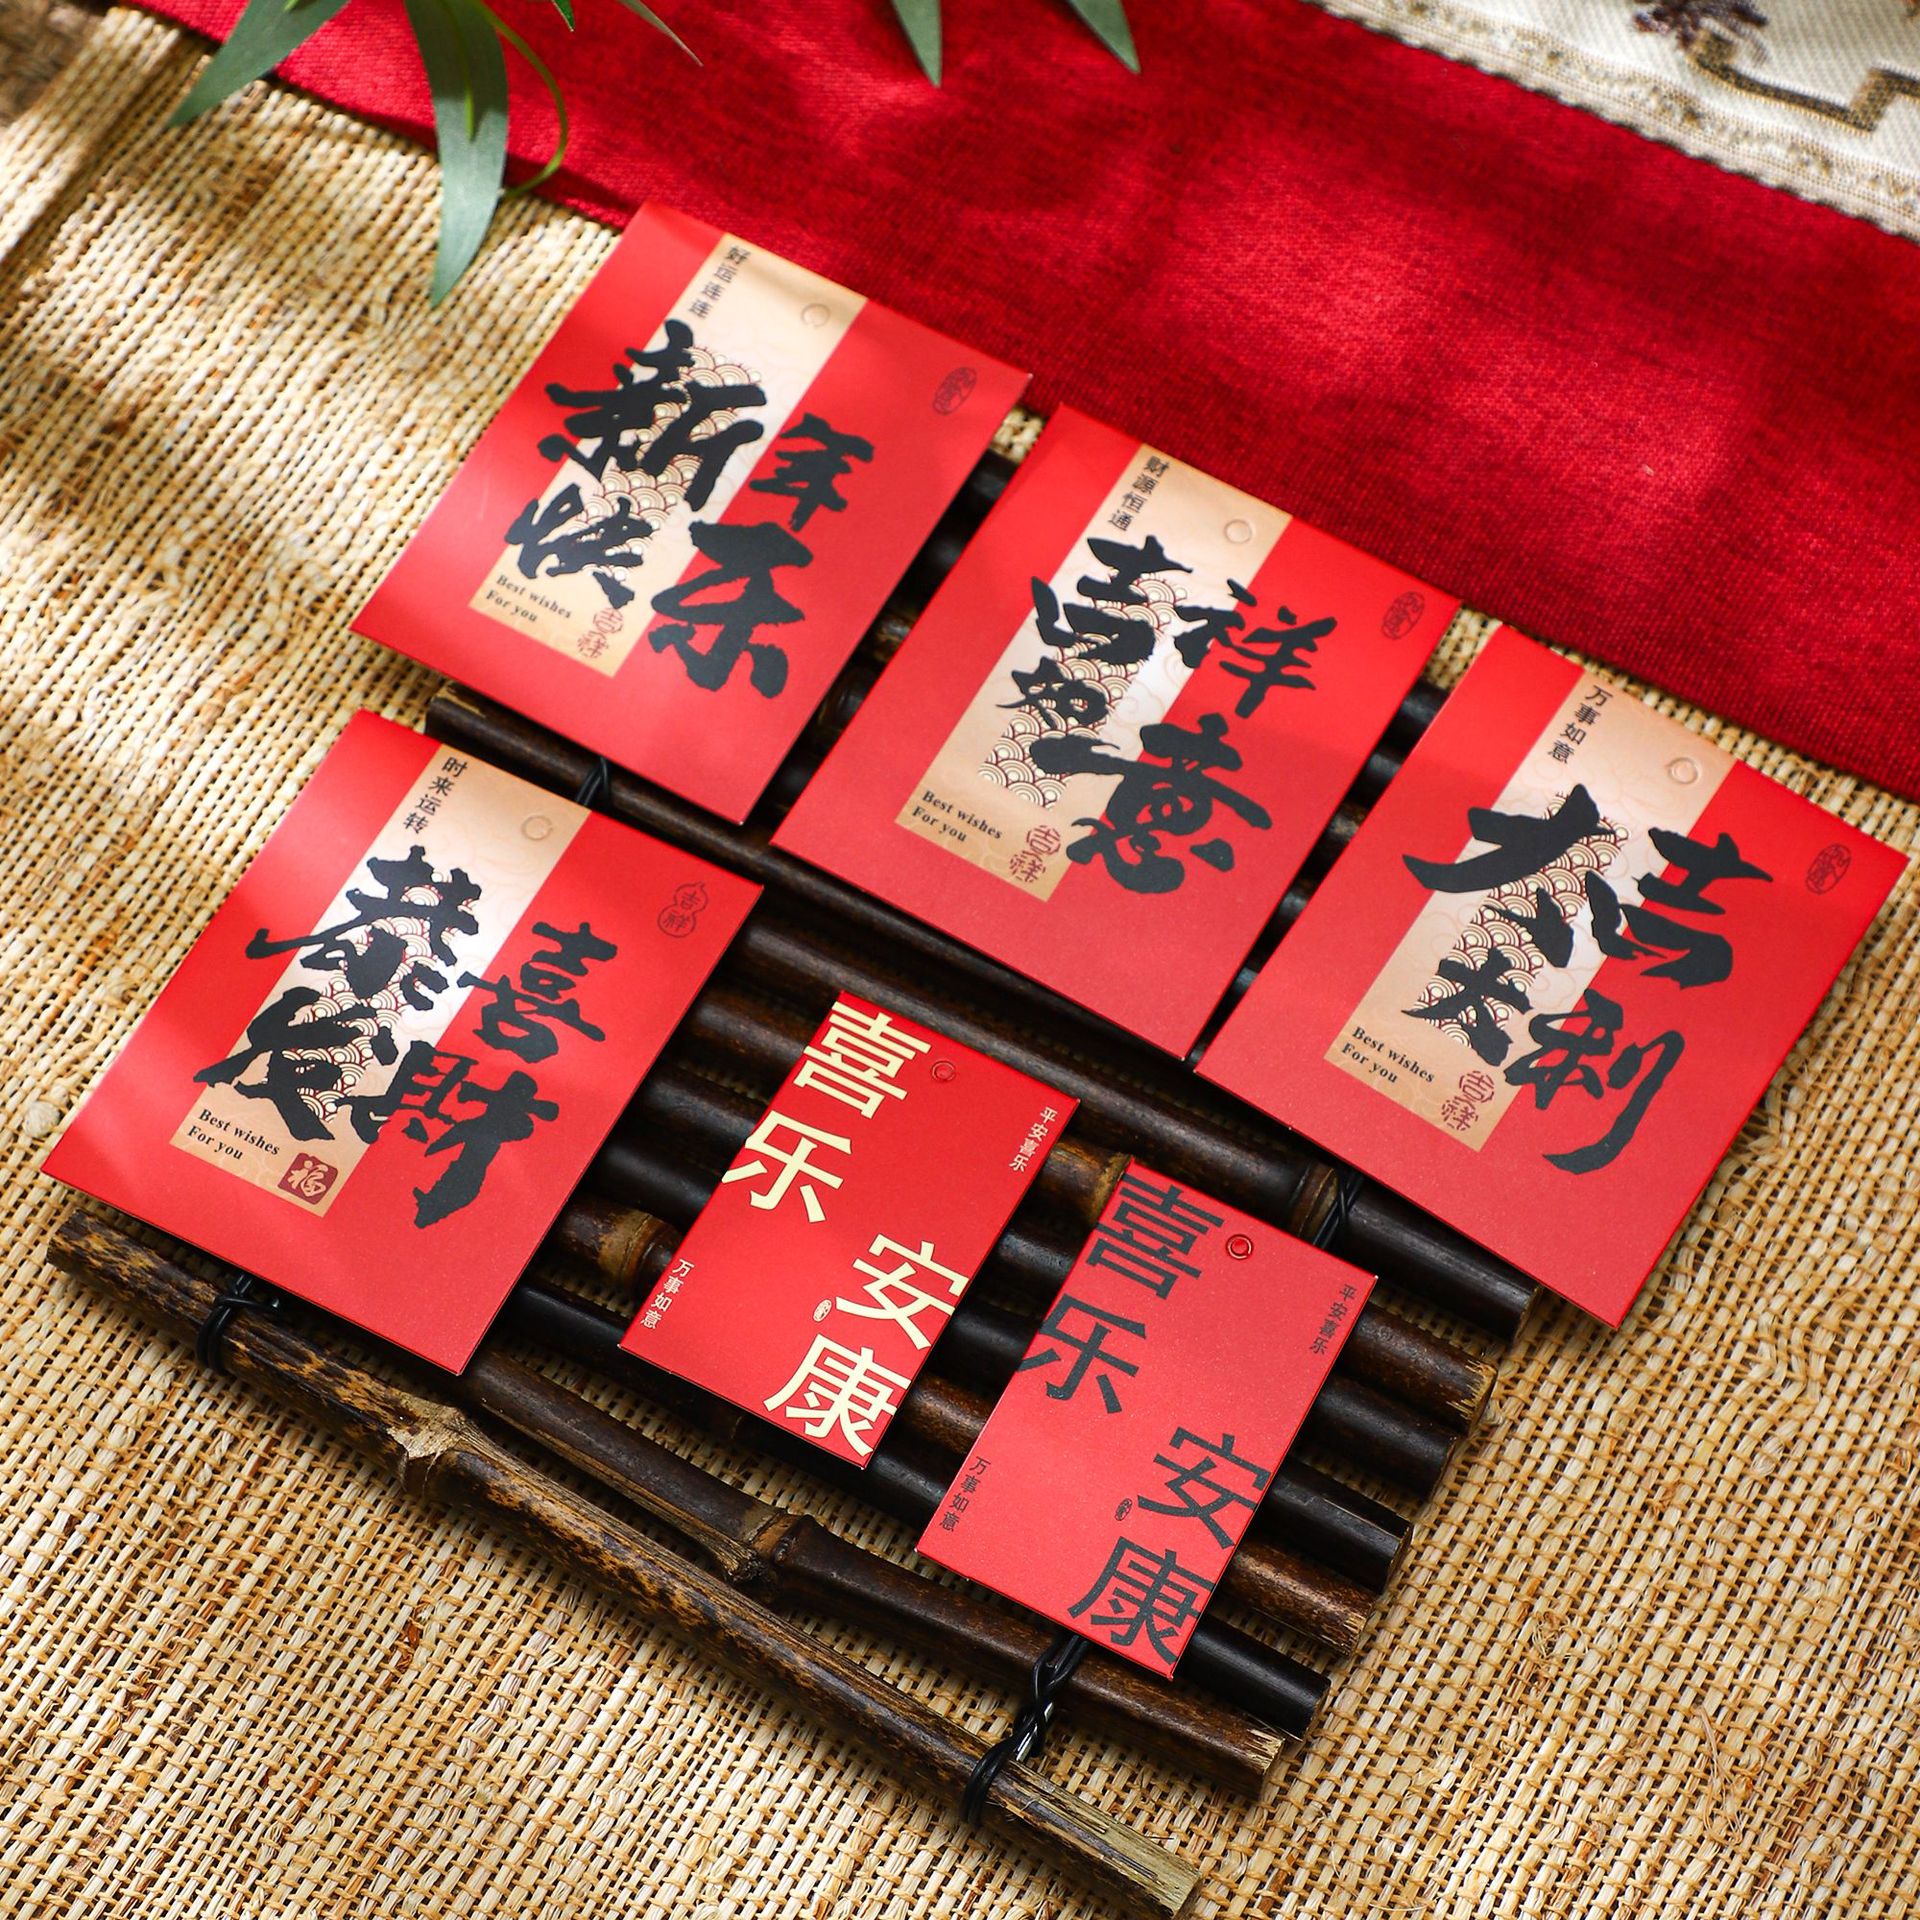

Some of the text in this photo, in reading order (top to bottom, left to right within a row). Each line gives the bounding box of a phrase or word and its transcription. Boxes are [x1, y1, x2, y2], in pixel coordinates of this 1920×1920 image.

[687, 246, 751, 320] 好运连连
[1108, 455, 1170, 532] 财源恒通
[486, 589, 538, 623] For you
[496, 574, 572, 619] Best wishes
[1547, 685, 1614, 764] 万事如意
[403, 756, 468, 835] 时来运转
[912, 806, 967, 842] For you
[922, 790, 1003, 839] Best wishes
[1342, 1042, 1398, 1084] For you
[1352, 1026, 1435, 1083] Best wishes
[187, 1125, 244, 1160] For you
[199, 1108, 280, 1155] Best wishes
[721, 1001, 932, 1223] 喜乐
[1009, 1105, 1058, 1173] 平安喜乐
[285, 1157, 331, 1200] 福
[640, 1258, 695, 1330] 万事如意
[1017, 1174, 1225, 1414] 喜乐
[1309, 1283, 1357, 1355] 平安喜乐
[764, 1234, 969, 1455] 安康
[939, 1456, 991, 1532] 万事如意
[1069, 1434, 1271, 1666] 安康
